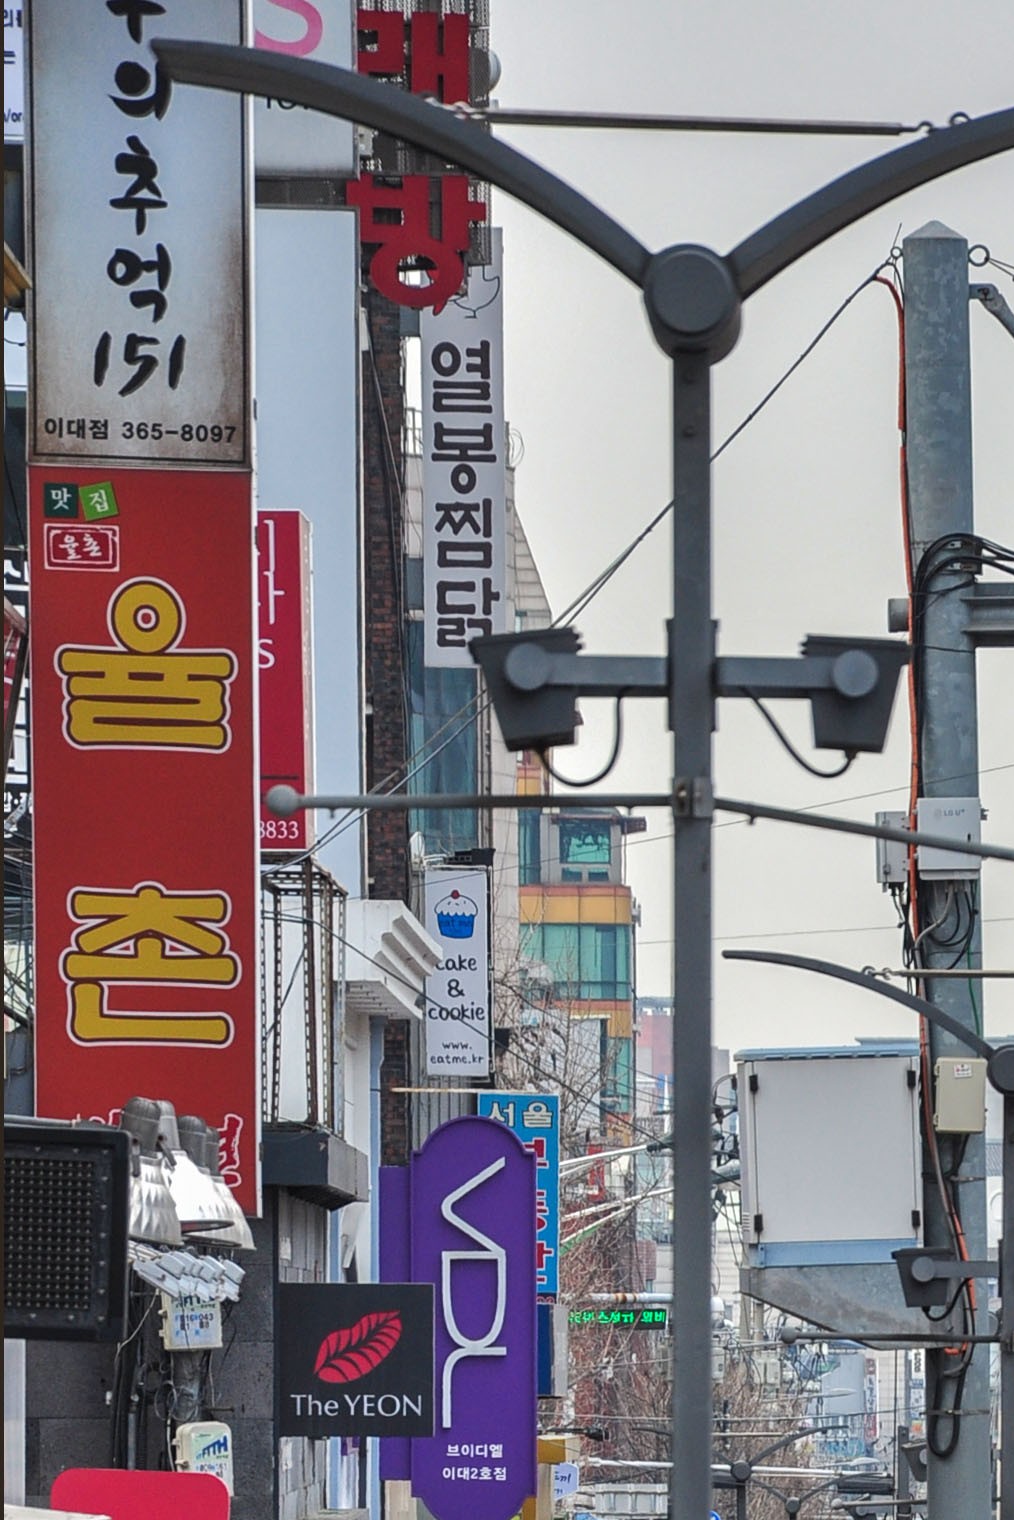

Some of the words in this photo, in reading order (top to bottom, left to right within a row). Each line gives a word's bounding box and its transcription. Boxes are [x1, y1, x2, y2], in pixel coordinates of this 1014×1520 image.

[108, 135, 172, 323] 추억
[93, 331, 186, 397] 151
[44, 417, 110, 440] 이대점
[122, 421, 238, 444] 365-8097
[436, 954, 477, 971] cake
[447, 979, 464, 998] &
[428, 1003, 486, 1021] cookie
[430, 1053, 485, 1065] eatme.kr
[290, 1394, 339, 1417] The
[344, 1394, 422, 1417] YEON
[446, 1444, 504, 1459] 브이디엘
[442, 1466, 507, 1482] 이대2호점
